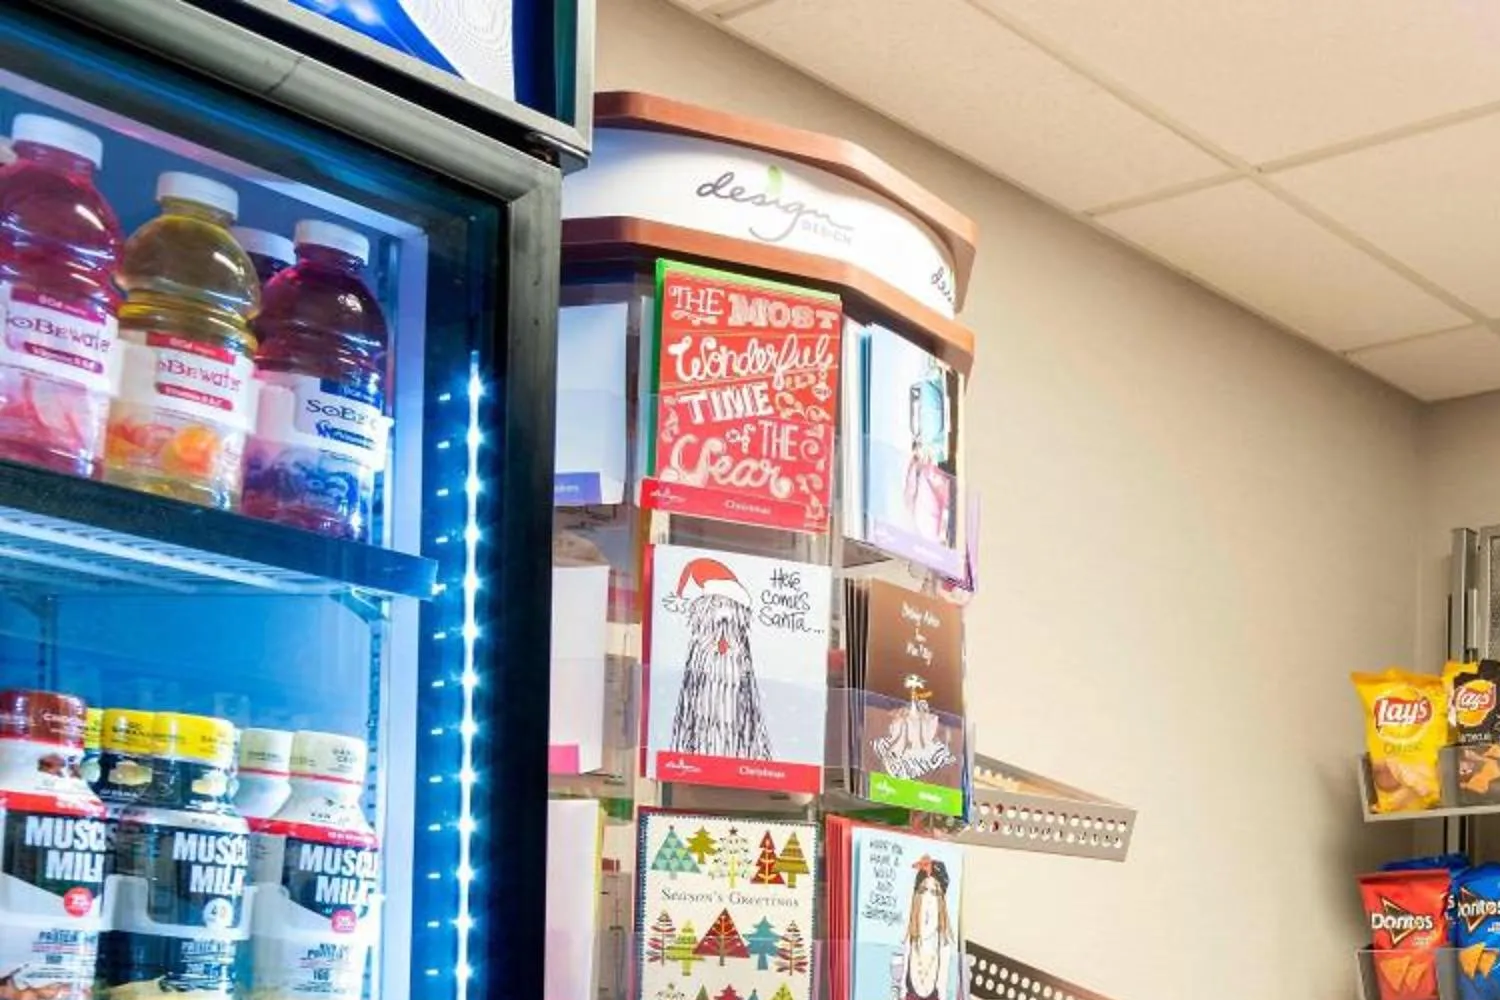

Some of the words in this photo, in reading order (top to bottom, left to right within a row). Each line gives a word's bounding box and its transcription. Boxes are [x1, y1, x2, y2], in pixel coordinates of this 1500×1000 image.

[669, 285, 726, 316] THE
[727, 293, 839, 330] MOST
[668, 333, 833, 391] Wonderful
[677, 382, 775, 425] TIME
[726, 423, 757, 454] of
[758, 419, 799, 461] THE
[658, 434, 794, 499] Year
[1375, 696, 1433, 726] Lay's
[1455, 687, 1496, 715] Lay's
[25, 815, 105, 851] MUSC
[172, 832, 249, 867] MUSC
[300, 843, 378, 878] MUSC
[1371, 911, 1434, 935] Doritos
